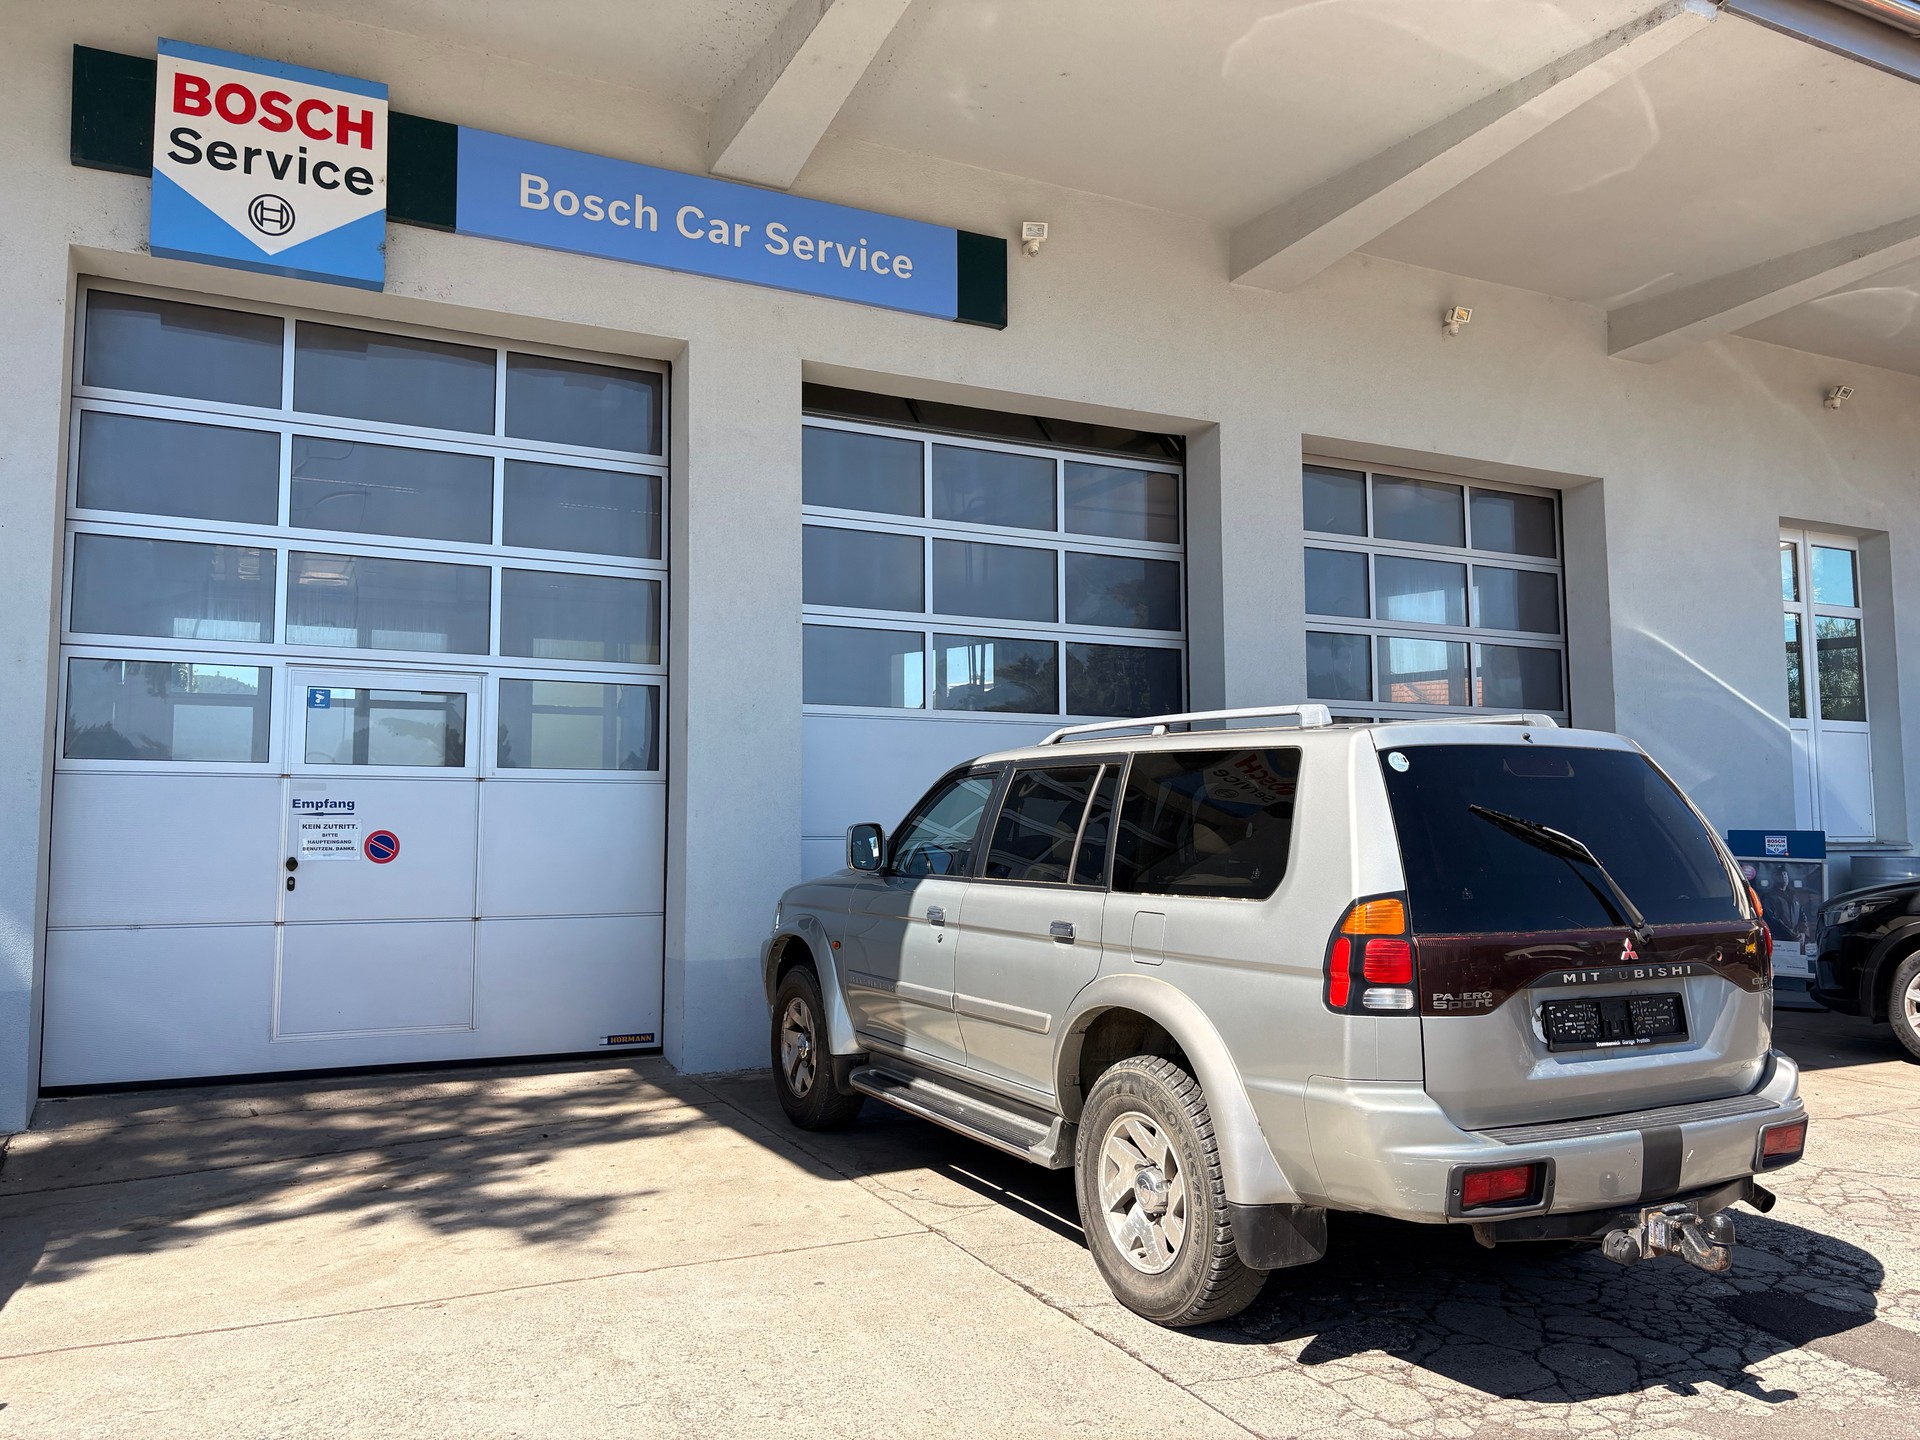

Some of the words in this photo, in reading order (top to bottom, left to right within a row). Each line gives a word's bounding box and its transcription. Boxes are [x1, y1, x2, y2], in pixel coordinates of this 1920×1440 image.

[172, 72, 374, 150] BOSCH
[167, 127, 374, 195] Service
[519, 172, 658, 232] Bosch
[676, 205, 750, 248] Car
[764, 222, 914, 279] Service
[292, 798, 355, 811] Empfang
[1563, 965, 1692, 984] MITUBISHI
[1432, 991, 1493, 1001] PAJERO
[1432, 998, 1493, 1011] Sport
